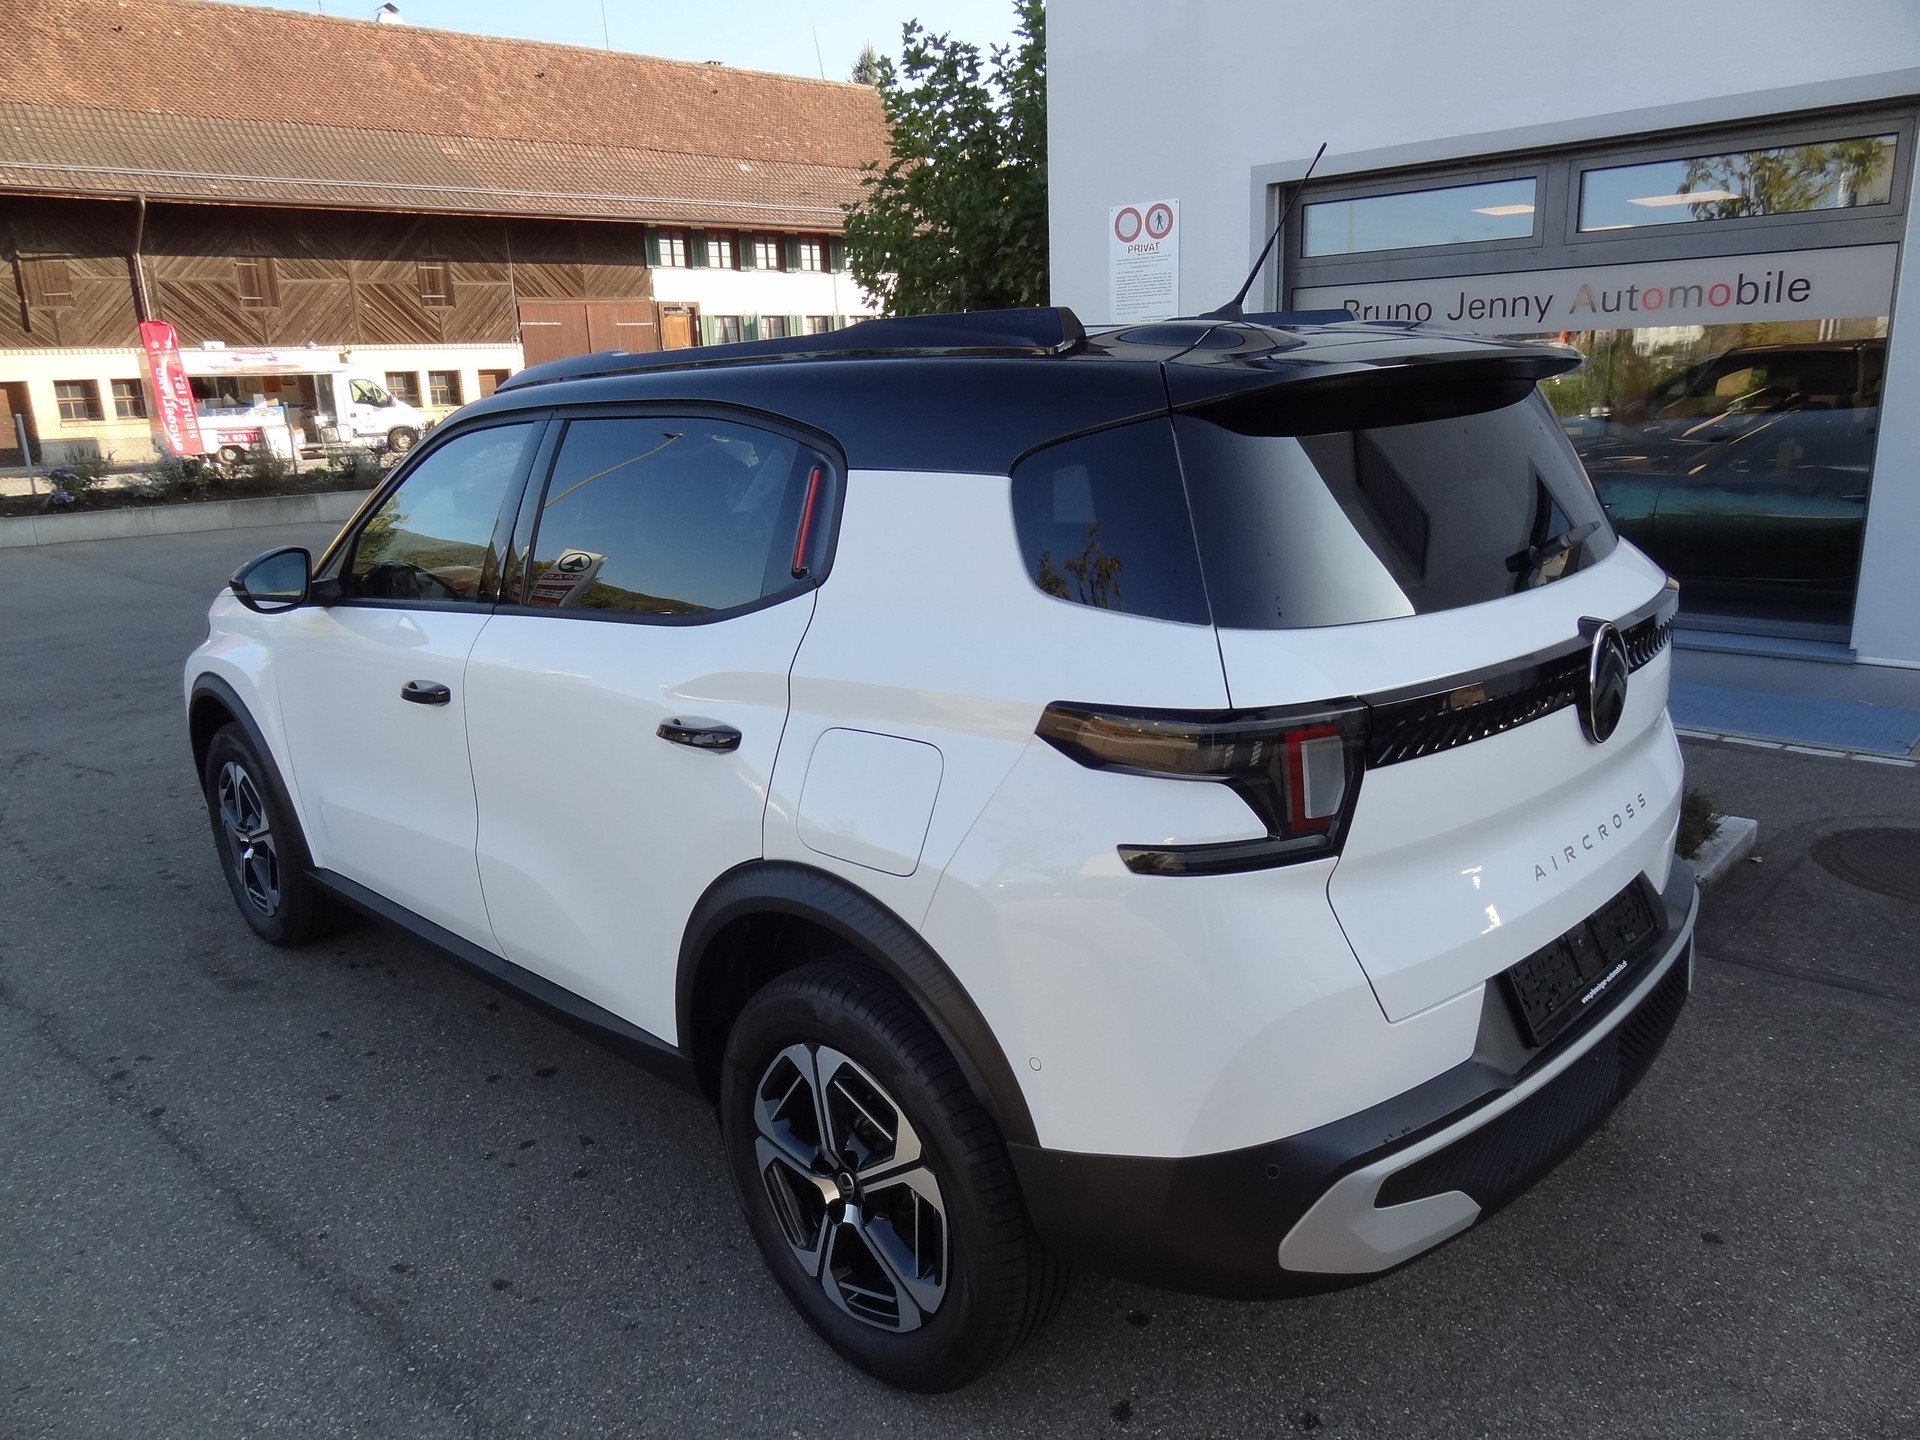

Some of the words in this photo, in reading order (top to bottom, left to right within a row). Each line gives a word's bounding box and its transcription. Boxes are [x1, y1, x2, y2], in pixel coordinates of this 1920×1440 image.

[1128, 242, 1160, 254] PRIVAT
[1343, 299, 1432, 322] Bruno
[1447, 292, 1554, 323] Jenny
[1568, 270, 1811, 315] Automobile
[1534, 793, 1647, 881] AIRCROSS
